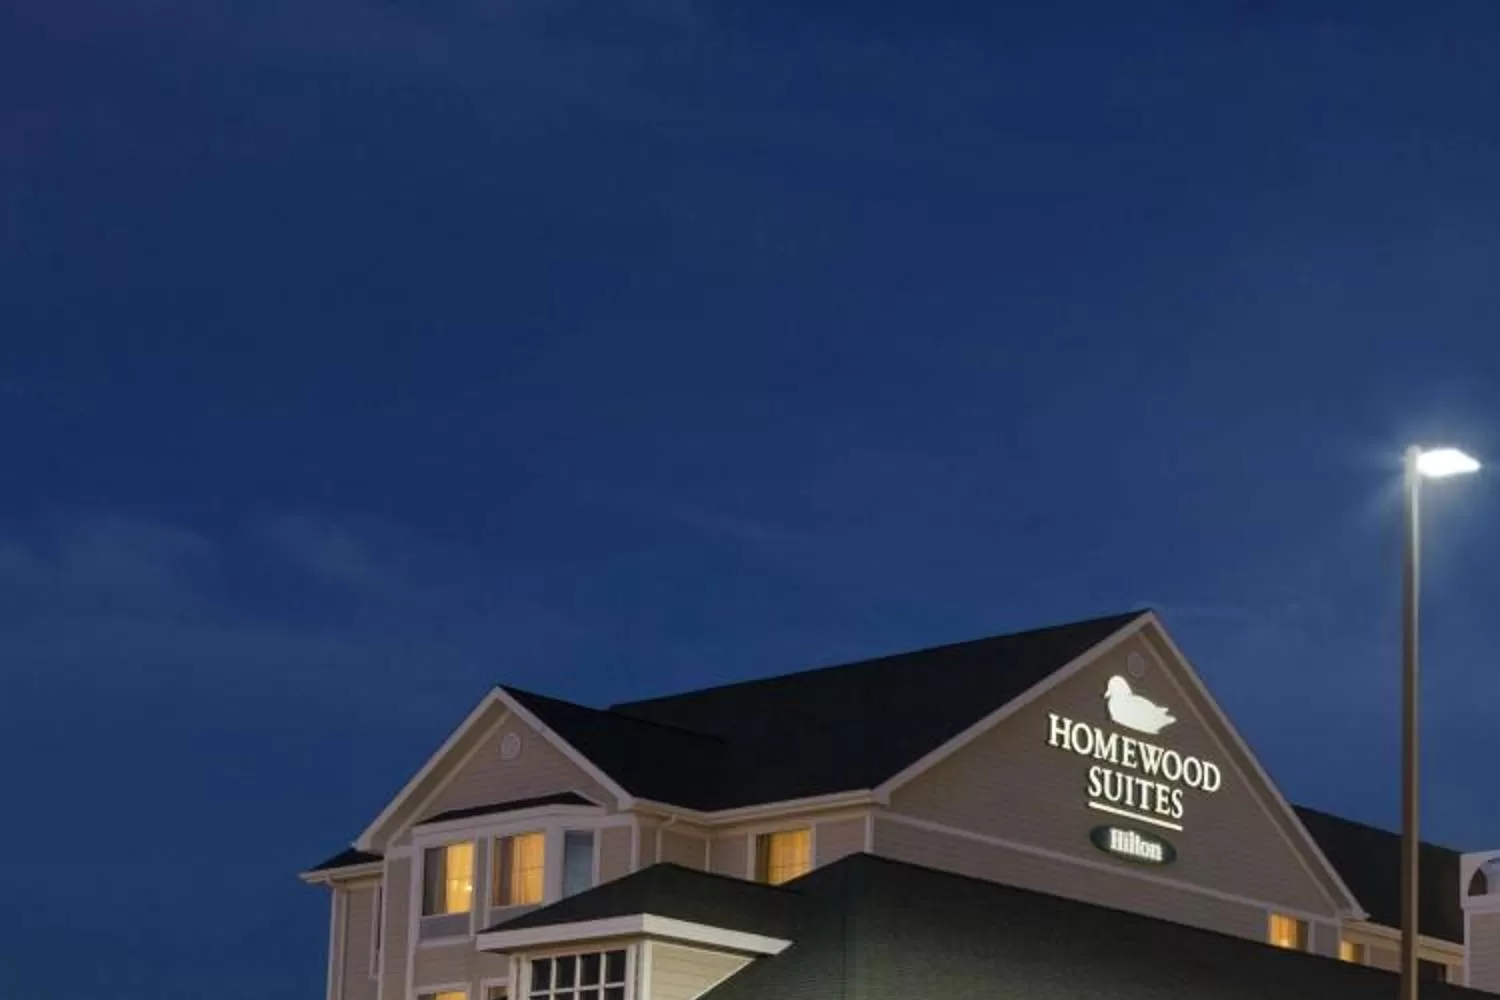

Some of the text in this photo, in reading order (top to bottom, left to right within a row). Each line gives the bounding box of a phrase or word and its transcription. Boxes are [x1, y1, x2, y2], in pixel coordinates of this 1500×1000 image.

[1048, 712, 1221, 792] HOMEWOOD
[1088, 765, 1184, 819] SUITES
[1109, 827, 1164, 862] Hilton
